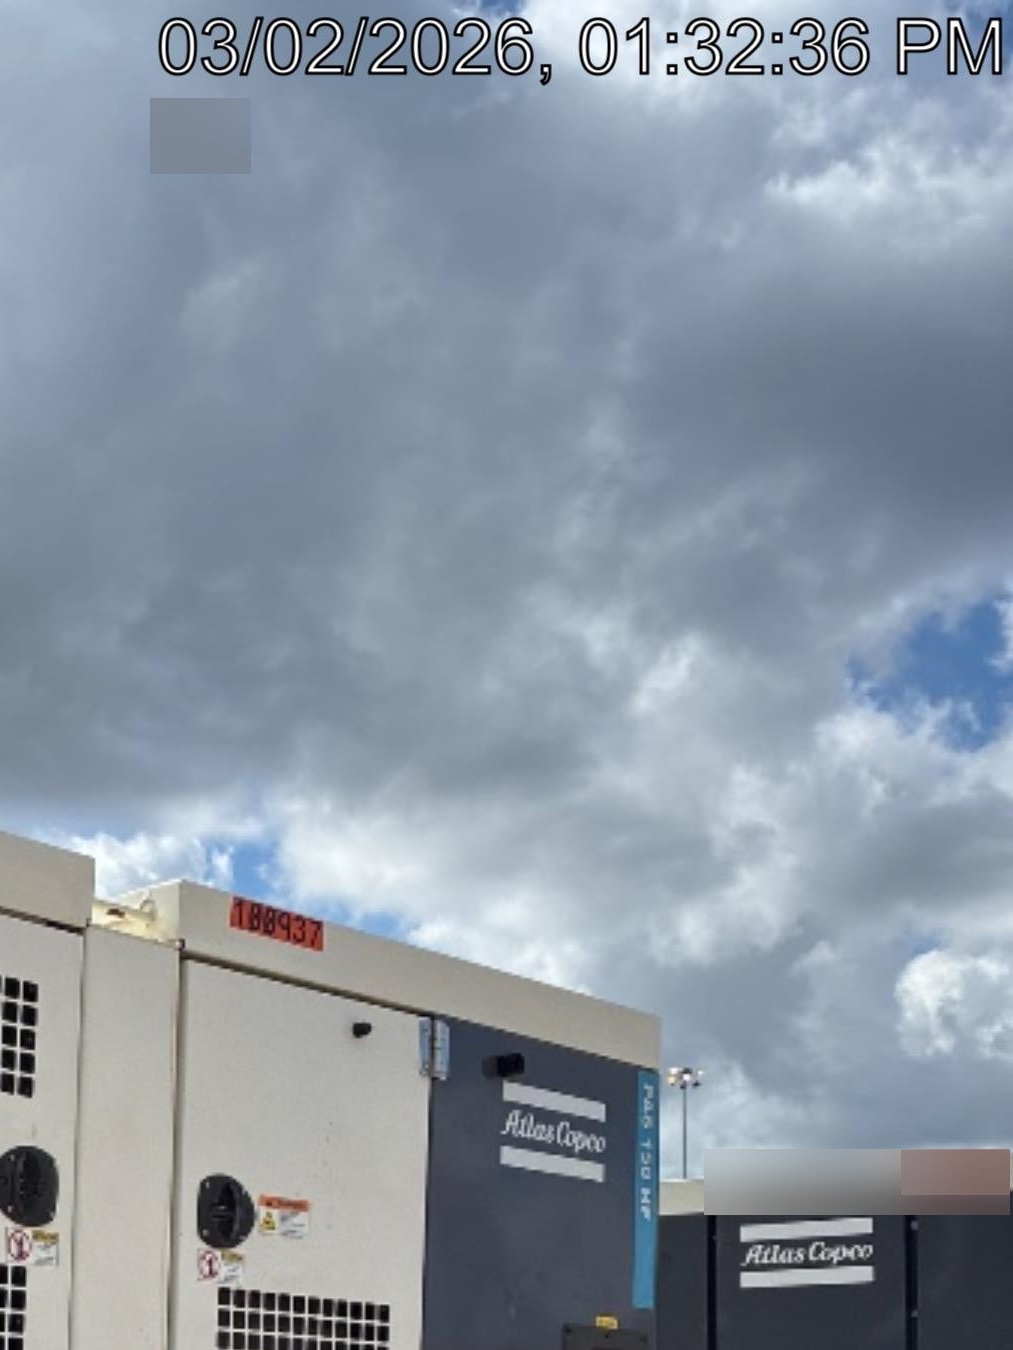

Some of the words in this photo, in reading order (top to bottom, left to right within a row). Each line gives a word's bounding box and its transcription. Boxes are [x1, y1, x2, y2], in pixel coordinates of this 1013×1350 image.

[499, 1110, 554, 1144] Atlas
[556, 1121, 606, 1154] Copco
[740, 1243, 804, 1266] Atlas
[808, 1241, 874, 1264] Copco
